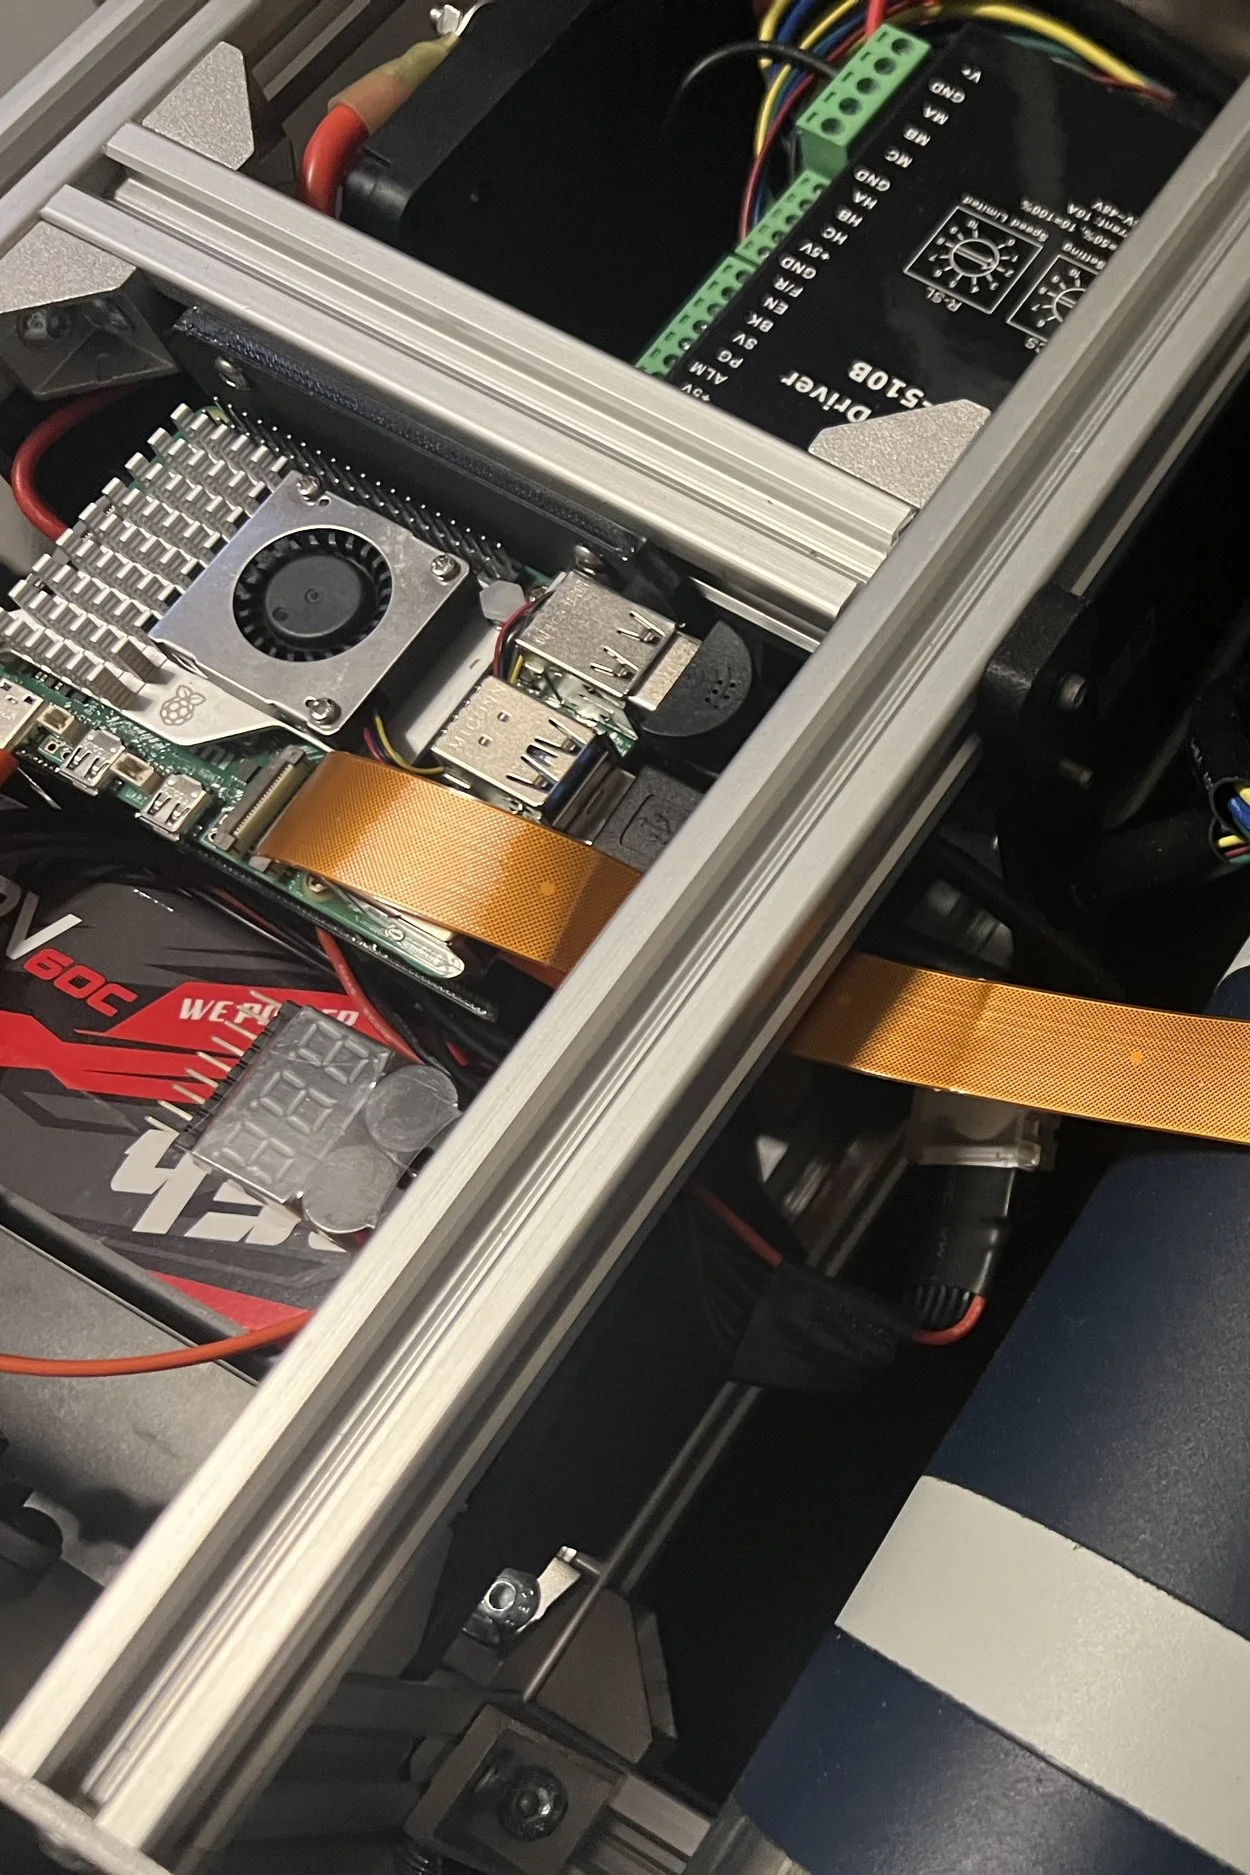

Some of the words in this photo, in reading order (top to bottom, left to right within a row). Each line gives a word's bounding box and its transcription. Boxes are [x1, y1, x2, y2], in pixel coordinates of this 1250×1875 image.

[929, 80, 966, 104] GND
[923, 105, 950, 126] MA
[903, 127, 932, 147] MB
[884, 148, 913, 169] MC
[854, 169, 891, 192] GND
[853, 191, 878, 210] HA
[963, 196, 1008, 223] Limited
[837, 208, 864, 227] HB
[1067, 203, 1092, 221] 10A
[821, 226, 849, 246] HC
[1010, 219, 1048, 243] Speed
[780, 256, 817, 280] GND
[774, 277, 804, 298] F/R
[763, 296, 789, 315] EN
[747, 313, 774, 333] BK
[732, 333, 758, 350] SV
[717, 349, 744, 369] PG
[689, 361, 729, 385] ALM
[780, 372, 872, 423] Driver
[24, 947, 138, 1017] 60C
[179, 998, 233, 1022] WE
